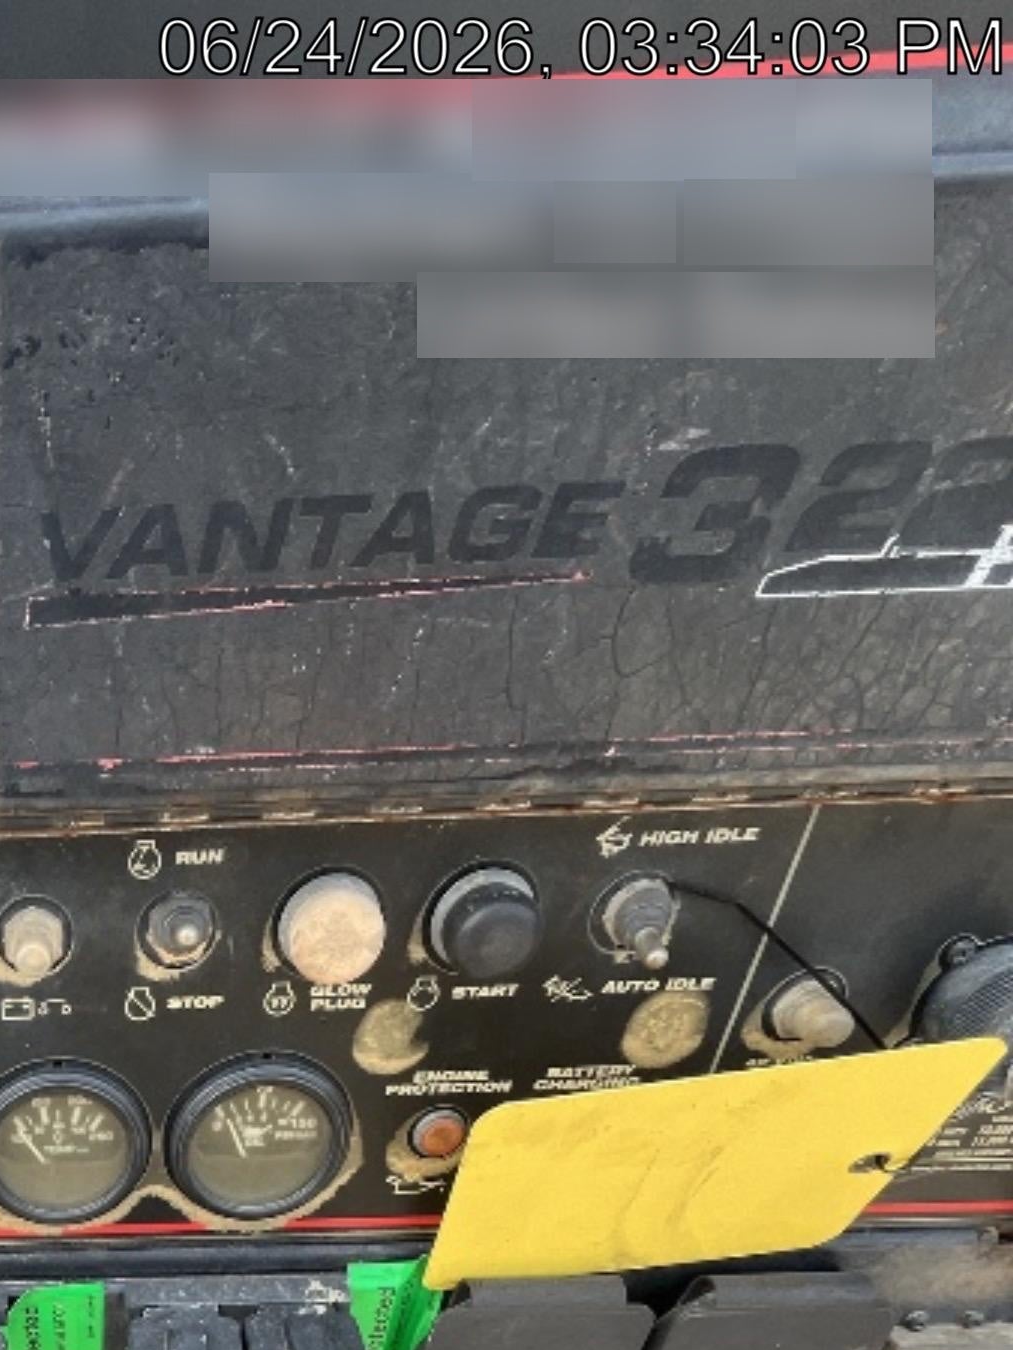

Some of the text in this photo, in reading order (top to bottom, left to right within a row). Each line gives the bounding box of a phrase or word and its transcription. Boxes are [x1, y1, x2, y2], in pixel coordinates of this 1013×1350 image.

[41, 480, 625, 580] VANTAGE
[639, 827, 762, 846] HIGH IDLE
[175, 849, 225, 865] RUN
[310, 984, 372, 996] GLOW
[451, 984, 519, 1000] START
[601, 976, 717, 994] AUTO IDLE
[166, 995, 225, 1010] STOP
[310, 997, 367, 1012] PLUG
[413, 1069, 490, 1084] ENGINE
[546, 1064, 637, 1079] BATTERY
[385, 1080, 513, 1096] PROTECTION
